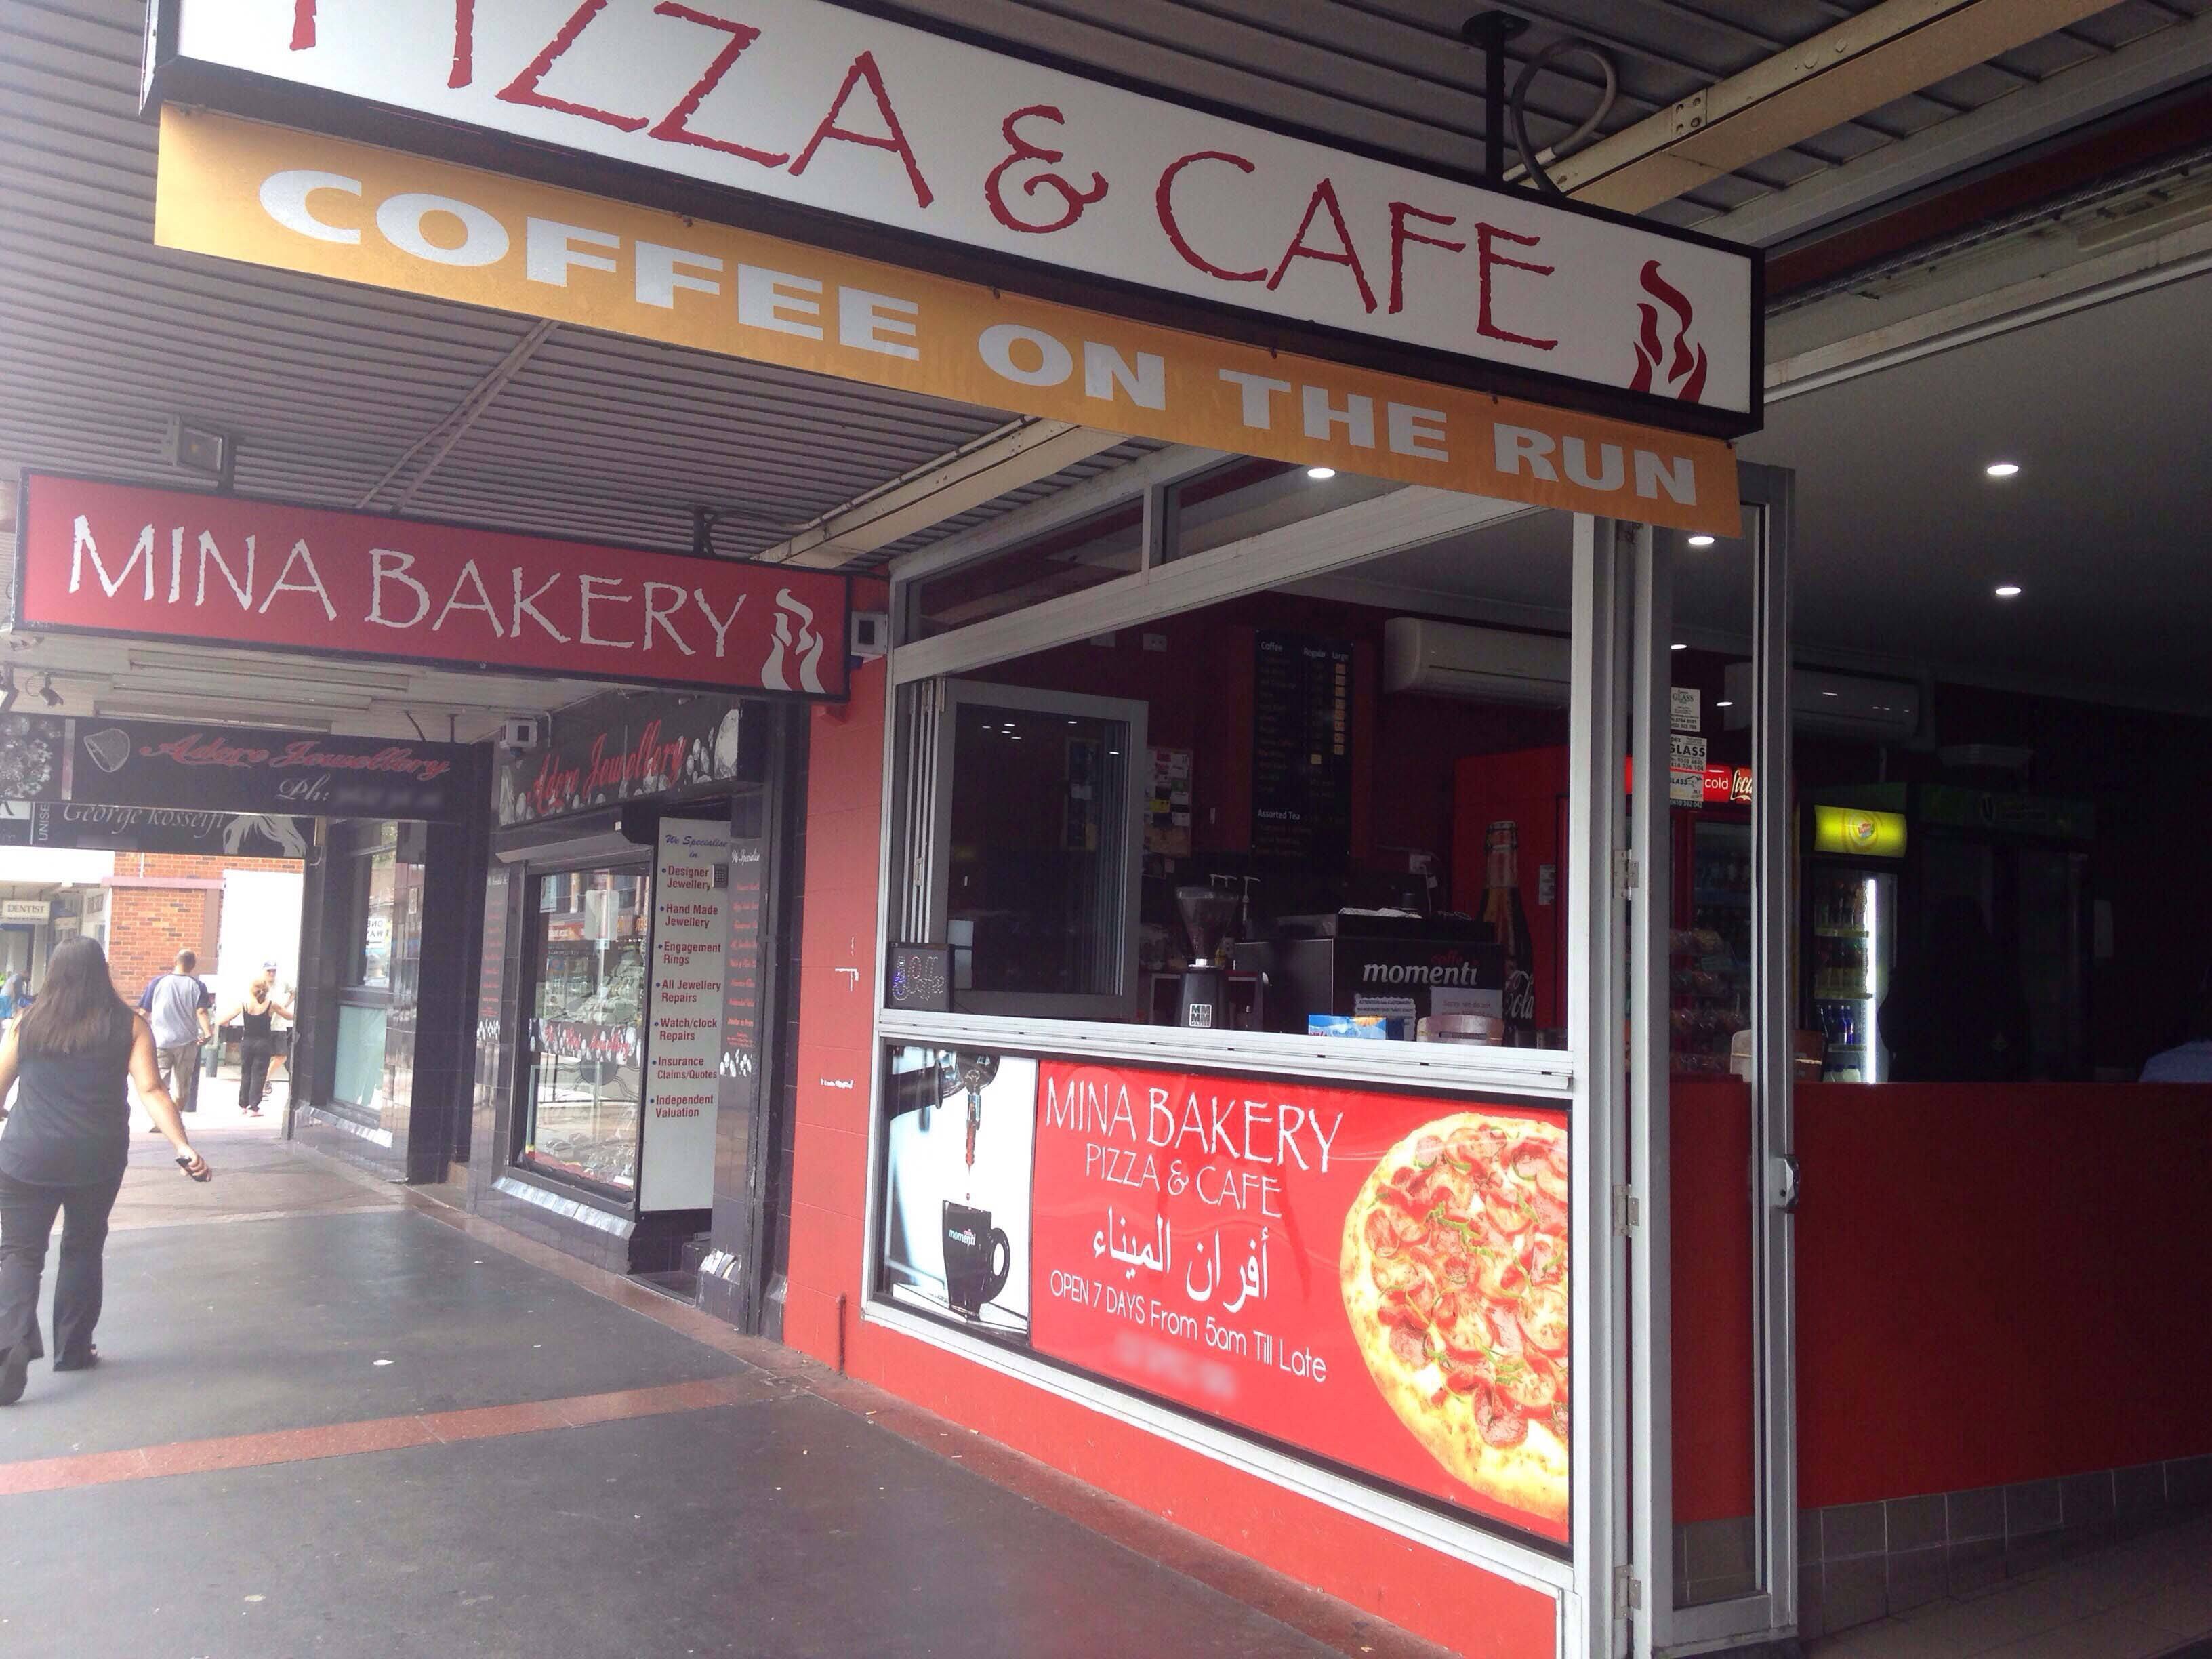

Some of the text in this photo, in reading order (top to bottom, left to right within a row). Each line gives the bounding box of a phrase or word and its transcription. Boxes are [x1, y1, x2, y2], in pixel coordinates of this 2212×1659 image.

[984, 104, 1109, 234] &
[1155, 150, 1559, 352] CAFE
[259, 169, 1697, 506] COFFEE ON THE RUN
[69, 514, 747, 657] MINA BAKERY
[1670, 743, 1705, 757] GLASS
[275, 773, 330, 802] Ph:
[1704, 777, 1728, 790] cold
[682, 836, 727, 847] Specialise
[668, 865, 709, 878] Designer
[667, 878, 710, 890] Jewellery
[7, 905, 45, 913] DENTIST
[666, 903, 718, 915] Hand Made
[665, 916, 710, 929] Jewellery
[664, 941, 721, 954] Engagement
[663, 954, 689, 966] Rings
[1363, 962, 1478, 986] momenti
[662, 979, 674, 989] All
[677, 980, 721, 992] Jewellery
[661, 992, 697, 1004] Repairs
[661, 1018, 717, 1028] Watch/clock
[660, 1031, 695, 1042] Repairs
[658, 1057, 704, 1066] Insurance
[657, 1070, 717, 1079] Claims/Quotes
[656, 1095, 714, 1106] Independent
[656, 1108, 699, 1118] Valuation
[1046, 1076, 1344, 1174] MINA BAKERY
[1085, 1143, 1282, 1219] PIZZA & CAFE
[1092, 1205, 1172, 1280] الميناء
[1050, 1269, 1090, 1304] OPEN
[1092, 1282, 1103, 1309] 7
[1106, 1287, 1146, 1324] DAYS
[1150, 1301, 1199, 1342] From
[1205, 1316, 1248, 1357] 5am
[1252, 1330, 1273, 1367] Till
[1279, 1339, 1328, 1383] Late
